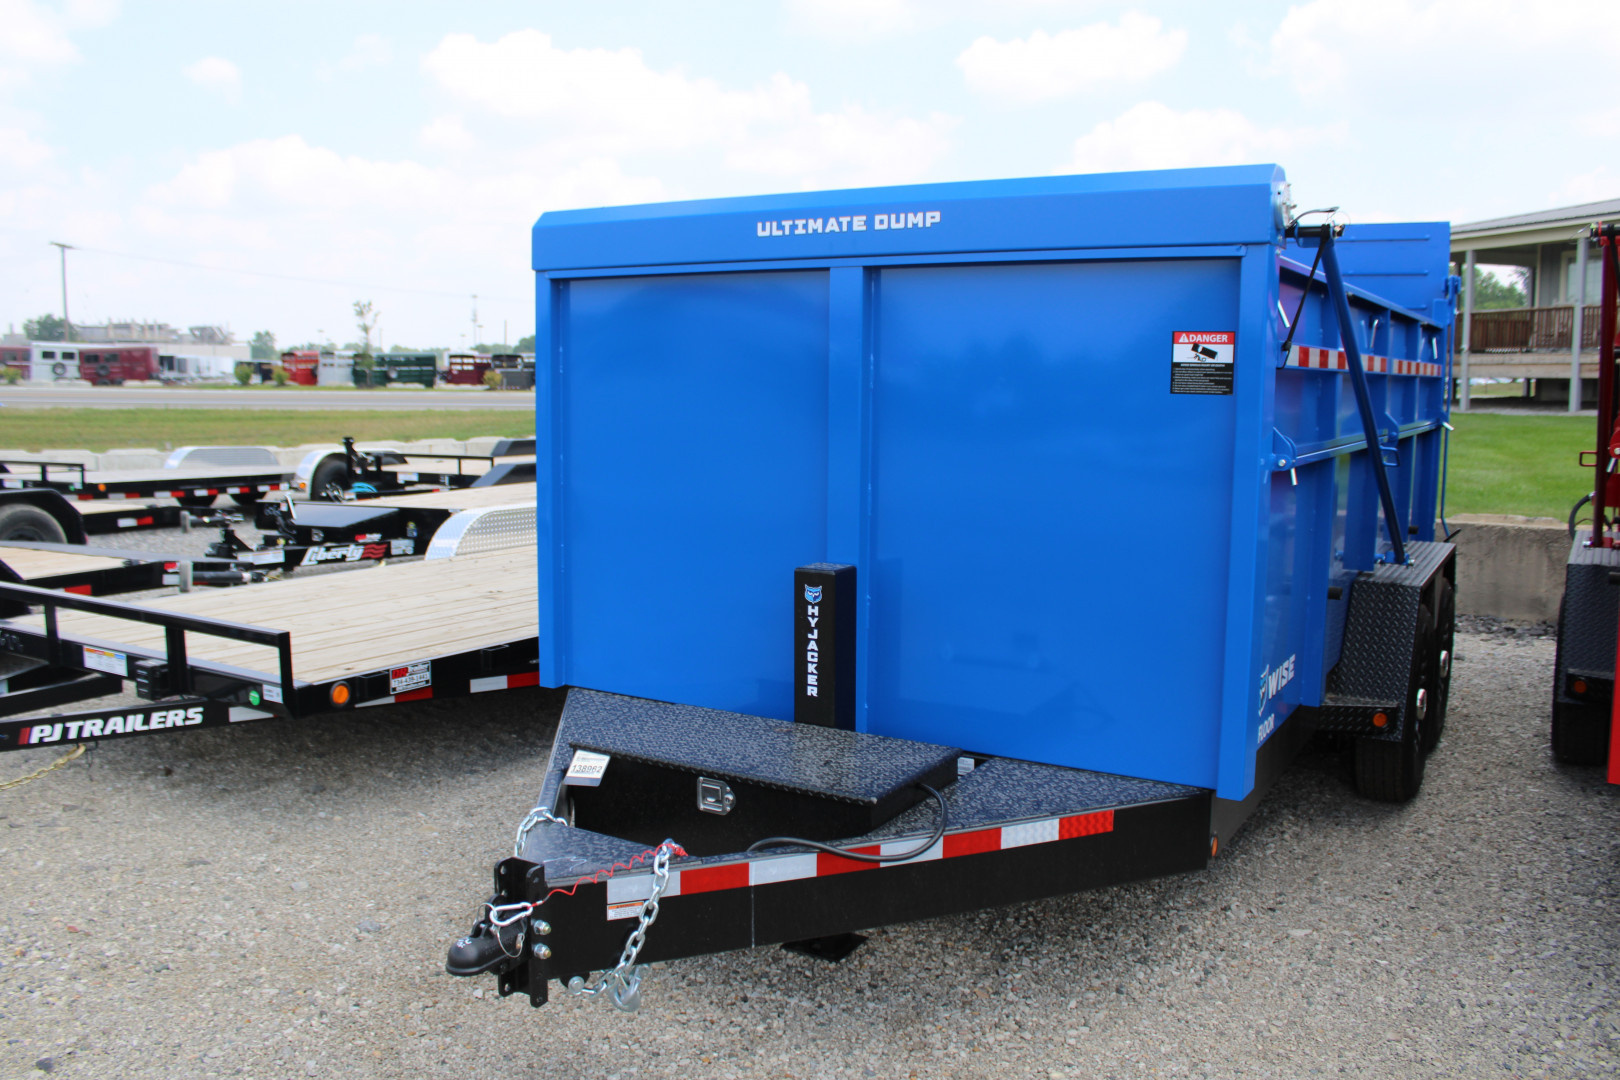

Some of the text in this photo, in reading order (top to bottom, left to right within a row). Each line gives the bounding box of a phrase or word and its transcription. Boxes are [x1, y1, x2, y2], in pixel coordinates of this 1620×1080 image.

[757, 211, 941, 237] ULTIMATE DUMP
[1189, 334, 1228, 343] DANGER
[301, 544, 365, 566] Liberty
[806, 605, 819, 697] HYJACKER
[29, 706, 204, 744] PJ TRAILERS
[571, 764, 603, 774] 138962
